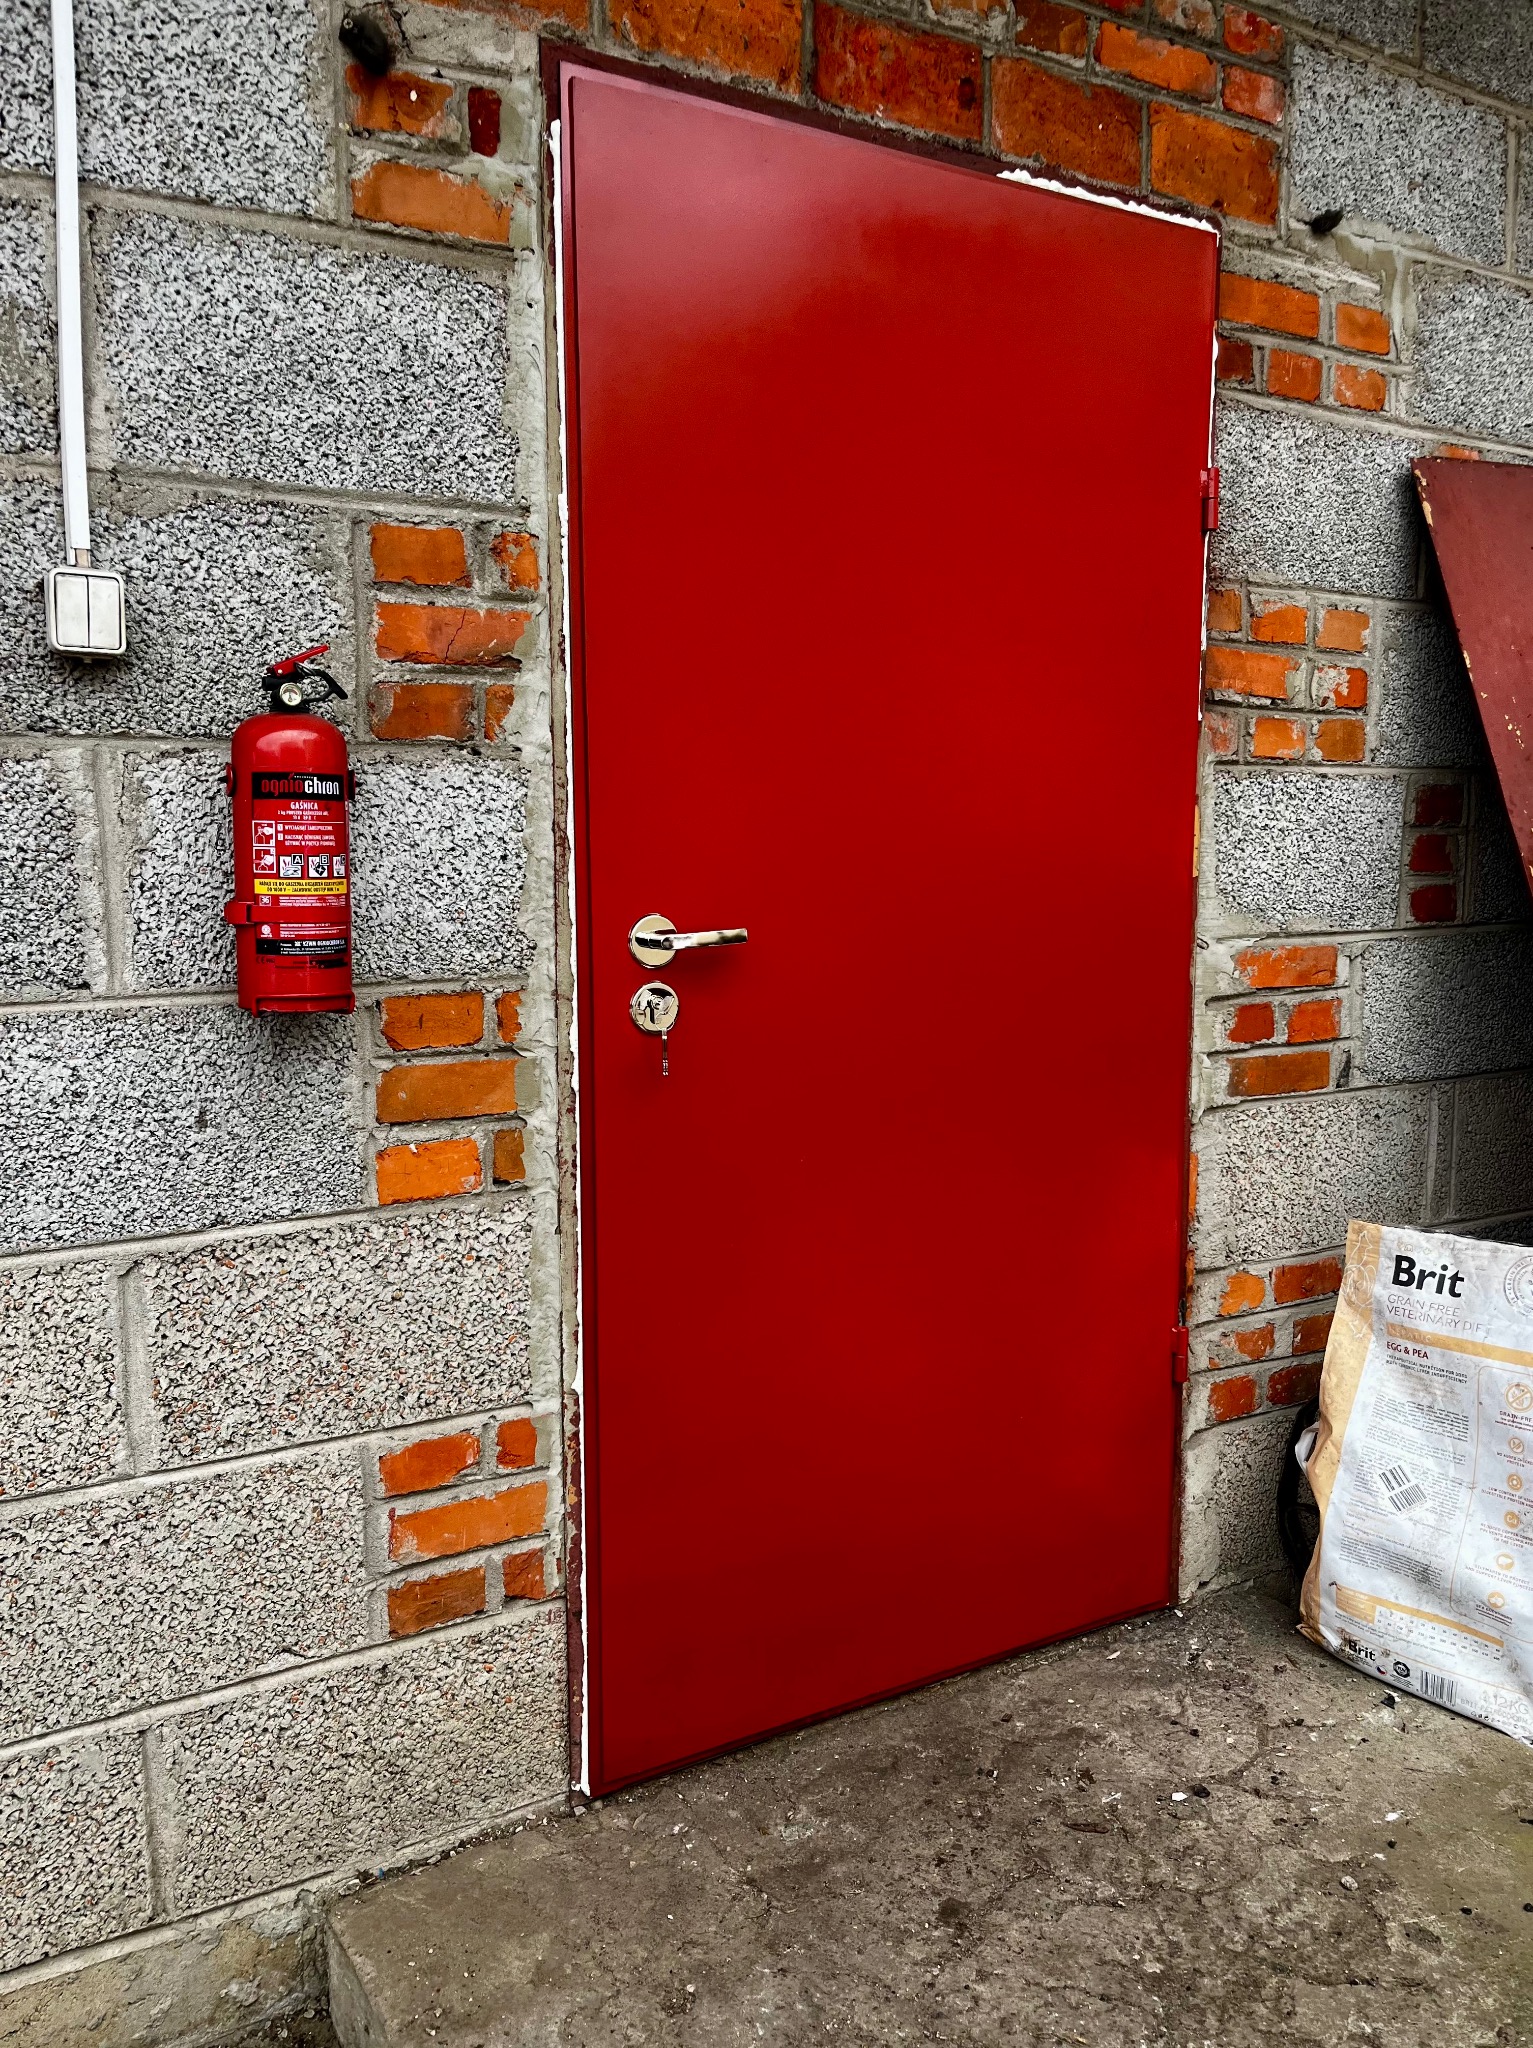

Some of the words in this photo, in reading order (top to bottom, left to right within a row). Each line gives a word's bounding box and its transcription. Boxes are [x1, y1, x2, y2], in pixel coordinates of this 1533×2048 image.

[290, 800, 319, 810] GAŚNICA
[293, 856, 302, 864] A
[321, 855, 328, 864] B
[1391, 1254, 1465, 1298] Brit
[1387, 1293, 1425, 1310] GRAIN
[1429, 1302, 1460, 1317] FREE
[1386, 1304, 1461, 1328] VETERINARY
[1386, 1341, 1402, 1353] EGG
[1403, 1346, 1411, 1355] &
[1412, 1348, 1429, 1360] PEA
[1499, 1410, 1533, 1423] GRAIN-FRE
[1512, 1581, 1533, 1591] FUNCTIO
[1348, 1639, 1376, 1661] Brit
